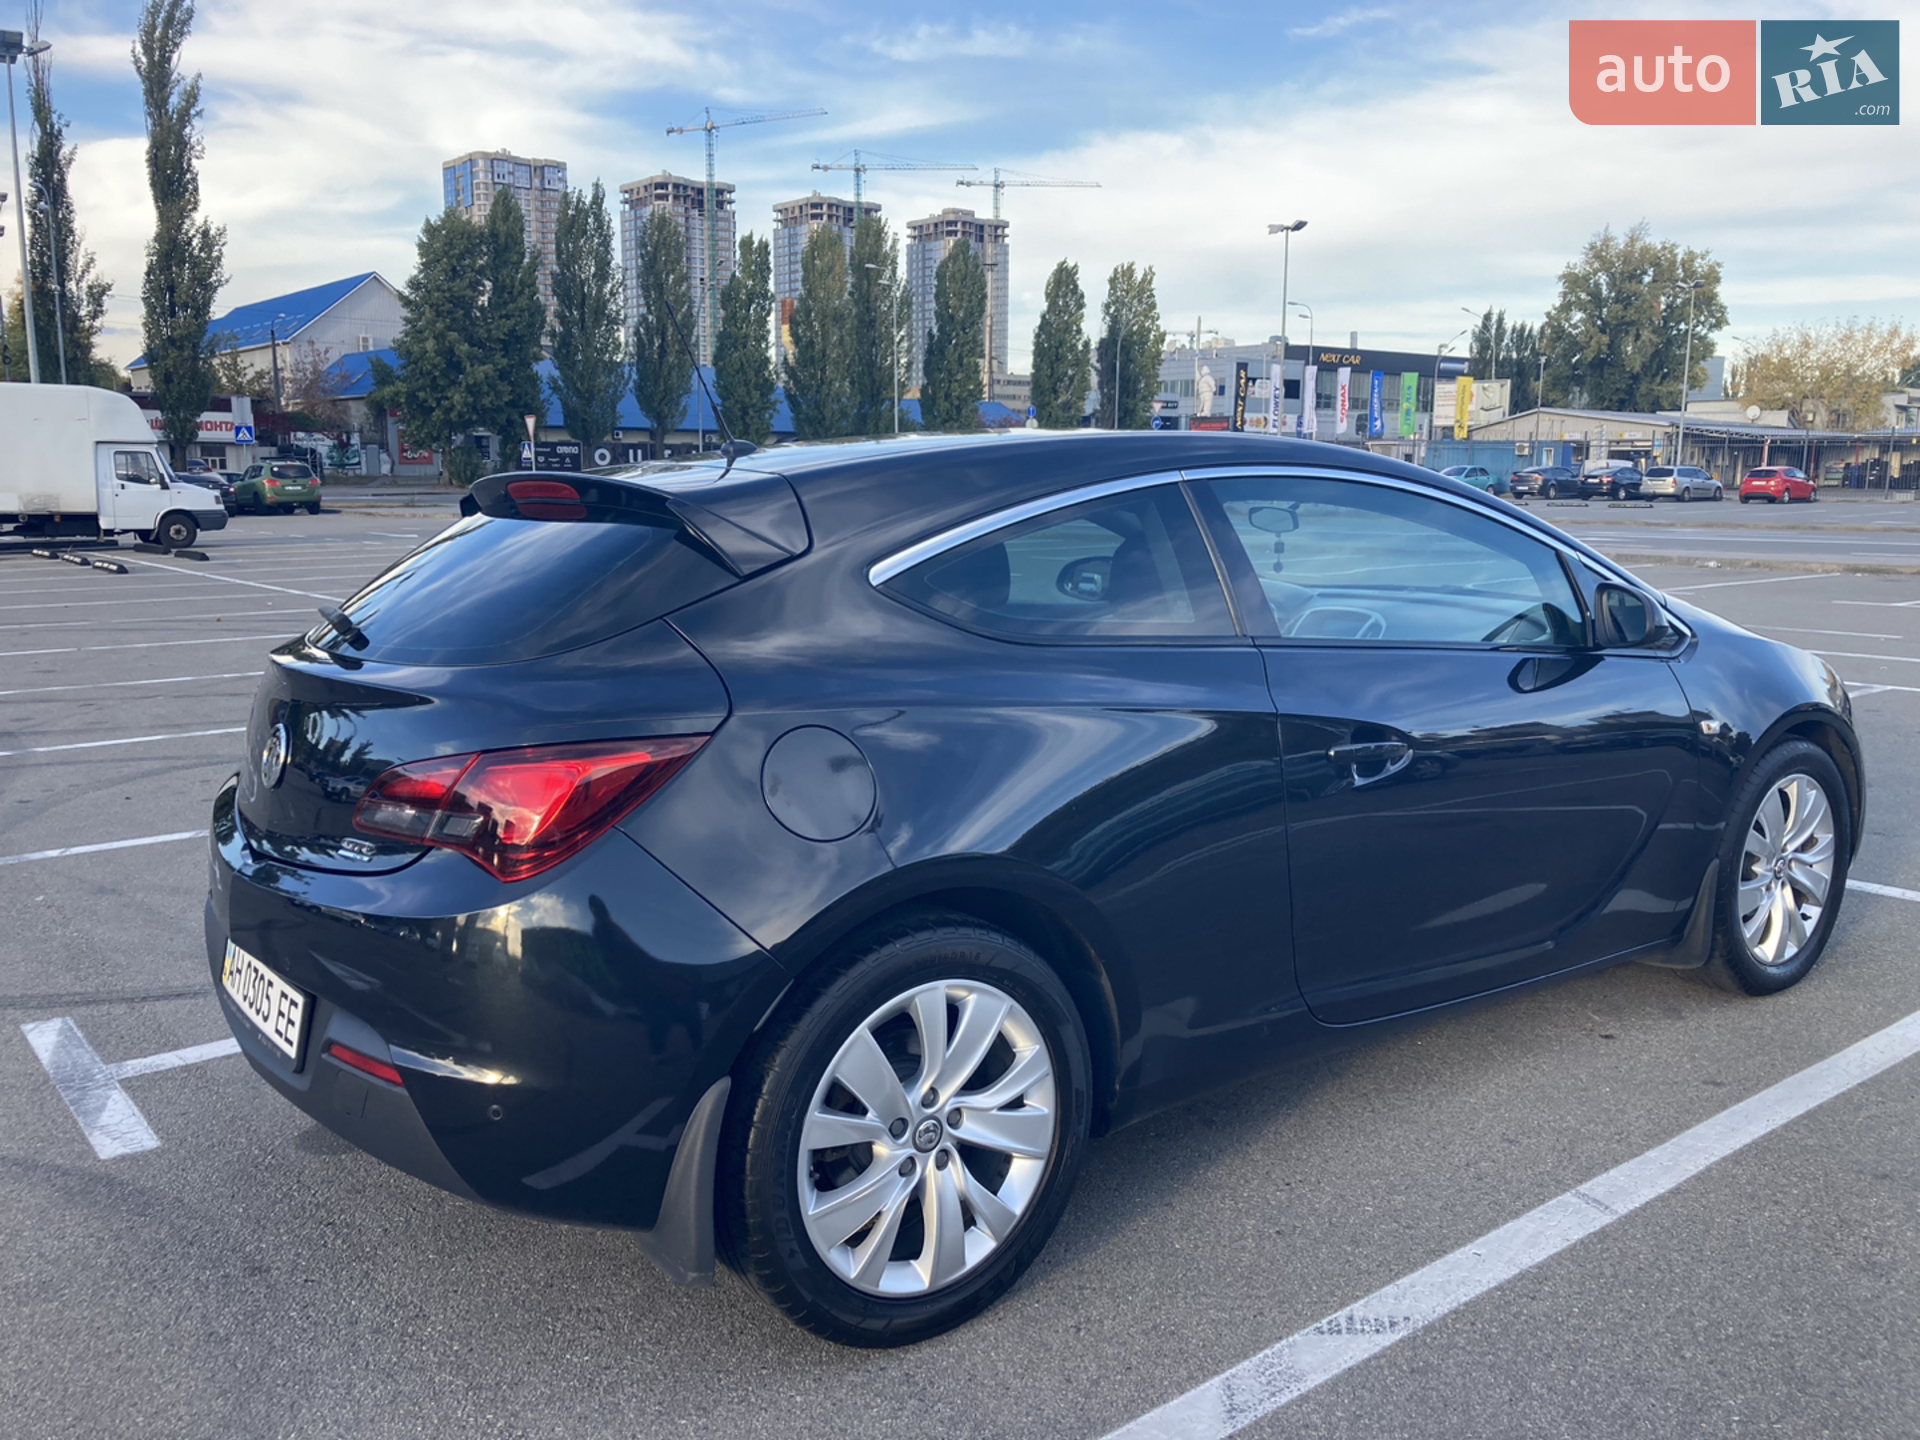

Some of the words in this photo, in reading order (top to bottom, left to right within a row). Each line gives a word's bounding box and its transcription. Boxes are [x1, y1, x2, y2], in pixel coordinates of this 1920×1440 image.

[1319, 352, 1341, 364] NEXT
[1342, 354, 1361, 365] CAR
[1272, 385, 1280, 429] FLOWEY
[556, 445, 579, 454] arena
[242, 959, 274, 1024] 0305
[274, 989, 299, 1048] EE
